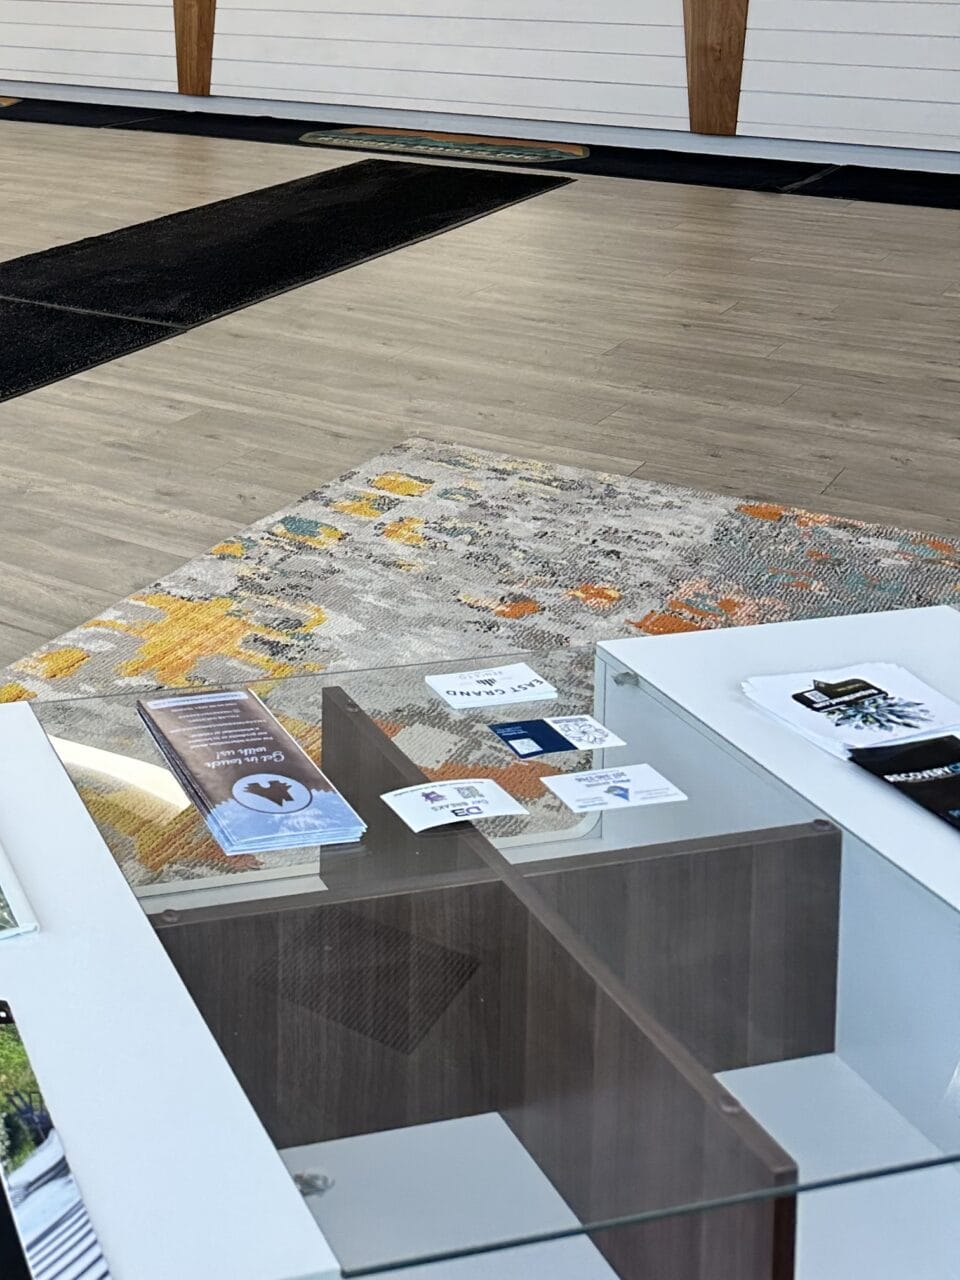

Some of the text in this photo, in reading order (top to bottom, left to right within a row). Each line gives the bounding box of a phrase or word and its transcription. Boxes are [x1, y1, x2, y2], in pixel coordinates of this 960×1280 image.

[445, 677, 544, 698] EAST GRAND
[215, 746, 267, 760] with us!
[261, 748, 285, 763] Get
[204, 758, 242, 769] touch
